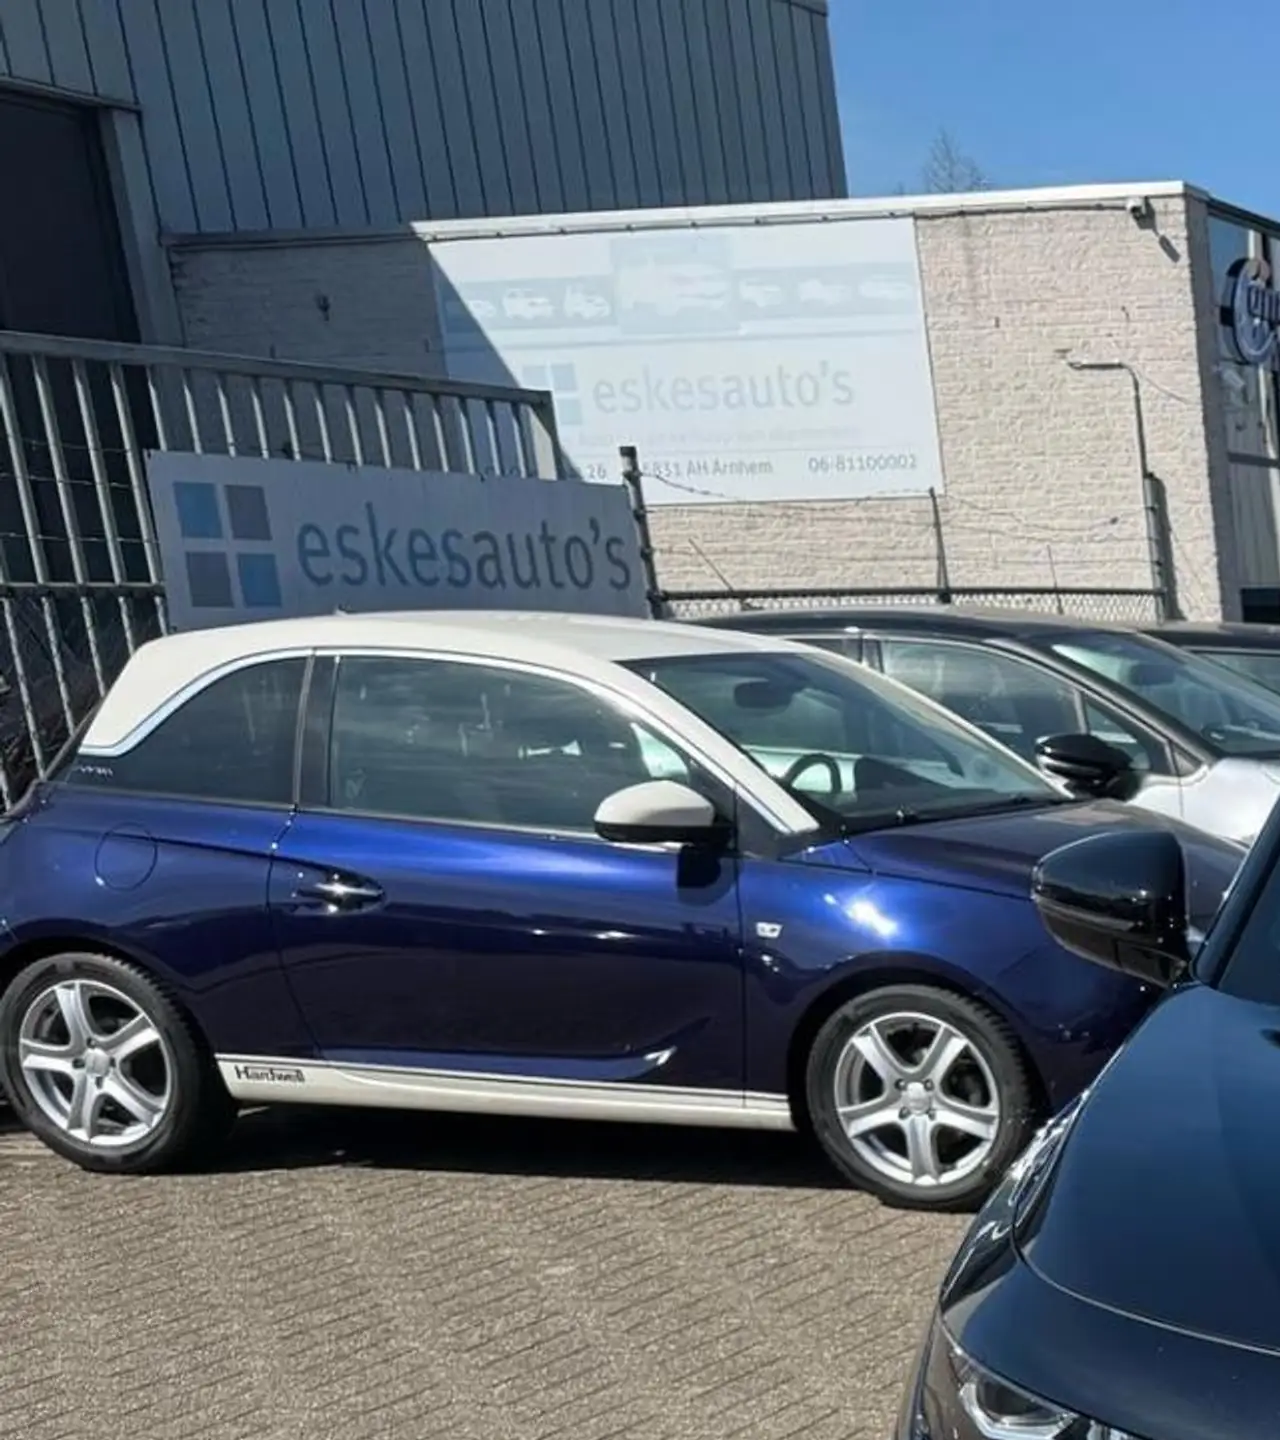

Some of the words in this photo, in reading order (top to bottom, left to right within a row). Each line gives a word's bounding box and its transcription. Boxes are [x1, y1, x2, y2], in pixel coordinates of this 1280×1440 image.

[592, 361, 855, 414] eskesauto's
[686, 458, 709, 477] AH
[712, 456, 773, 476] Arnhem
[297, 502, 632, 592] eskesauto's
